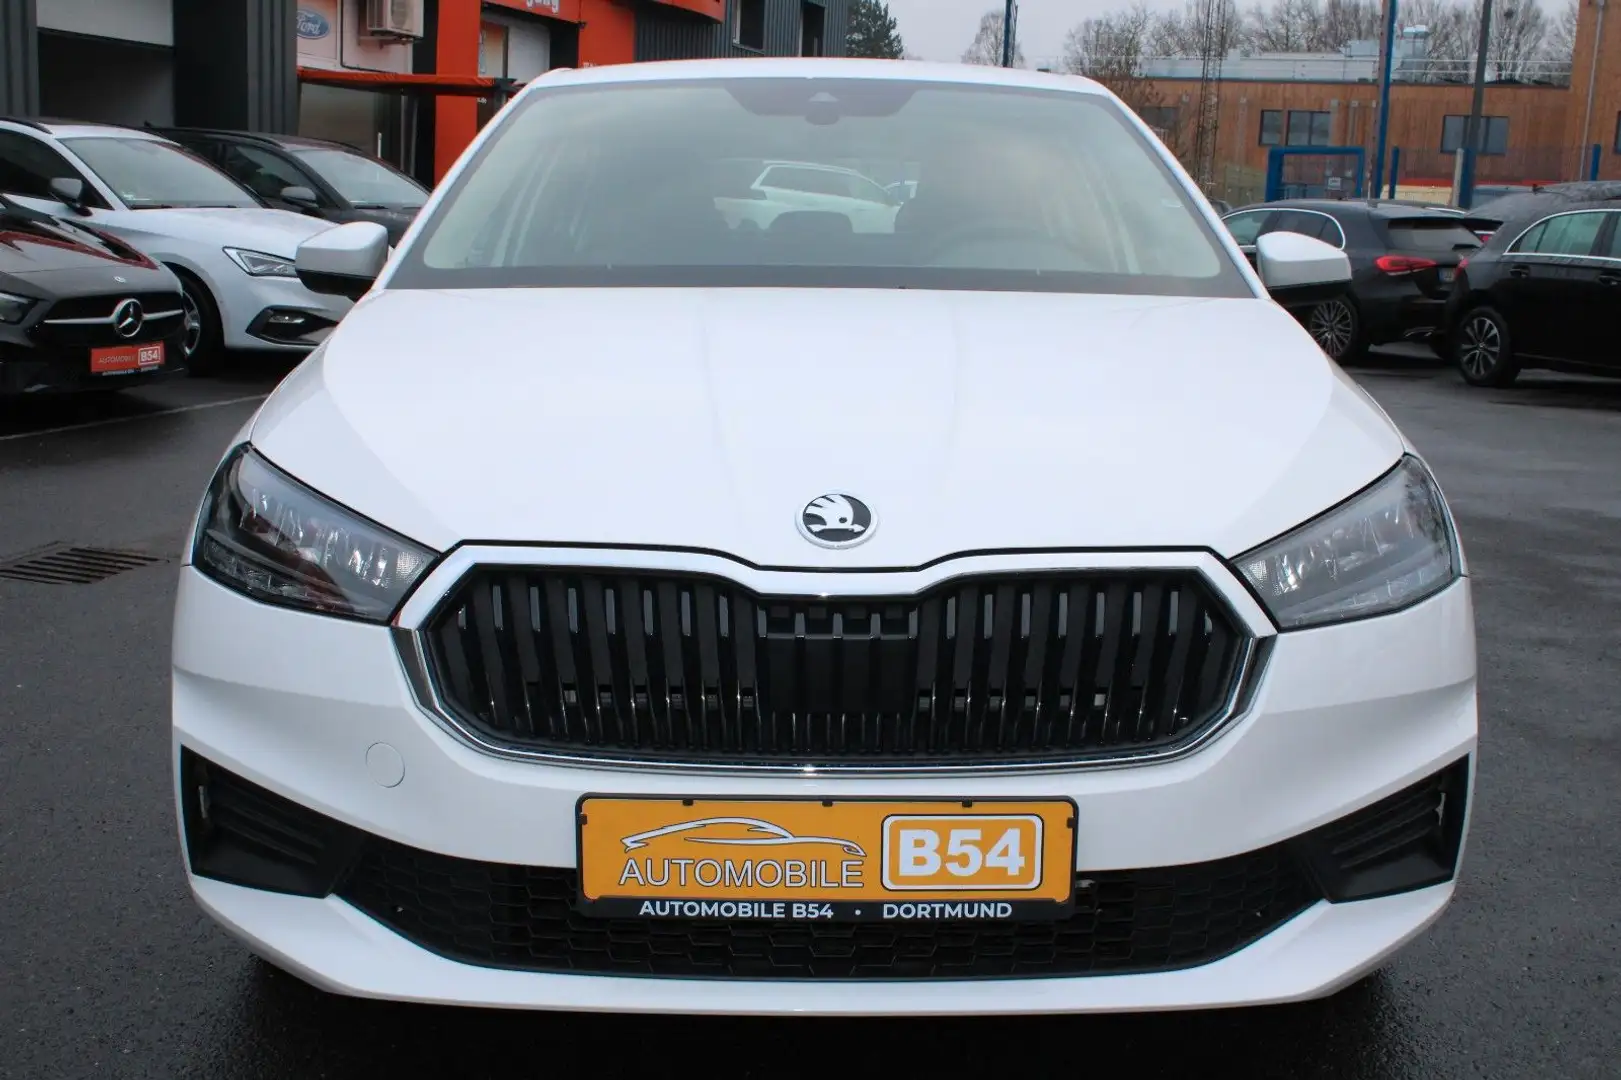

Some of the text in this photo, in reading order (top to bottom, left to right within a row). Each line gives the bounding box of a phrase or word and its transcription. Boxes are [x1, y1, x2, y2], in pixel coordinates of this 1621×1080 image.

[140, 350, 158, 362] B54
[618, 828, 1025, 888] AUTOMOBILE B54
[640, 901, 1012, 919] AUTOMOBILE B54 DORTMUND
